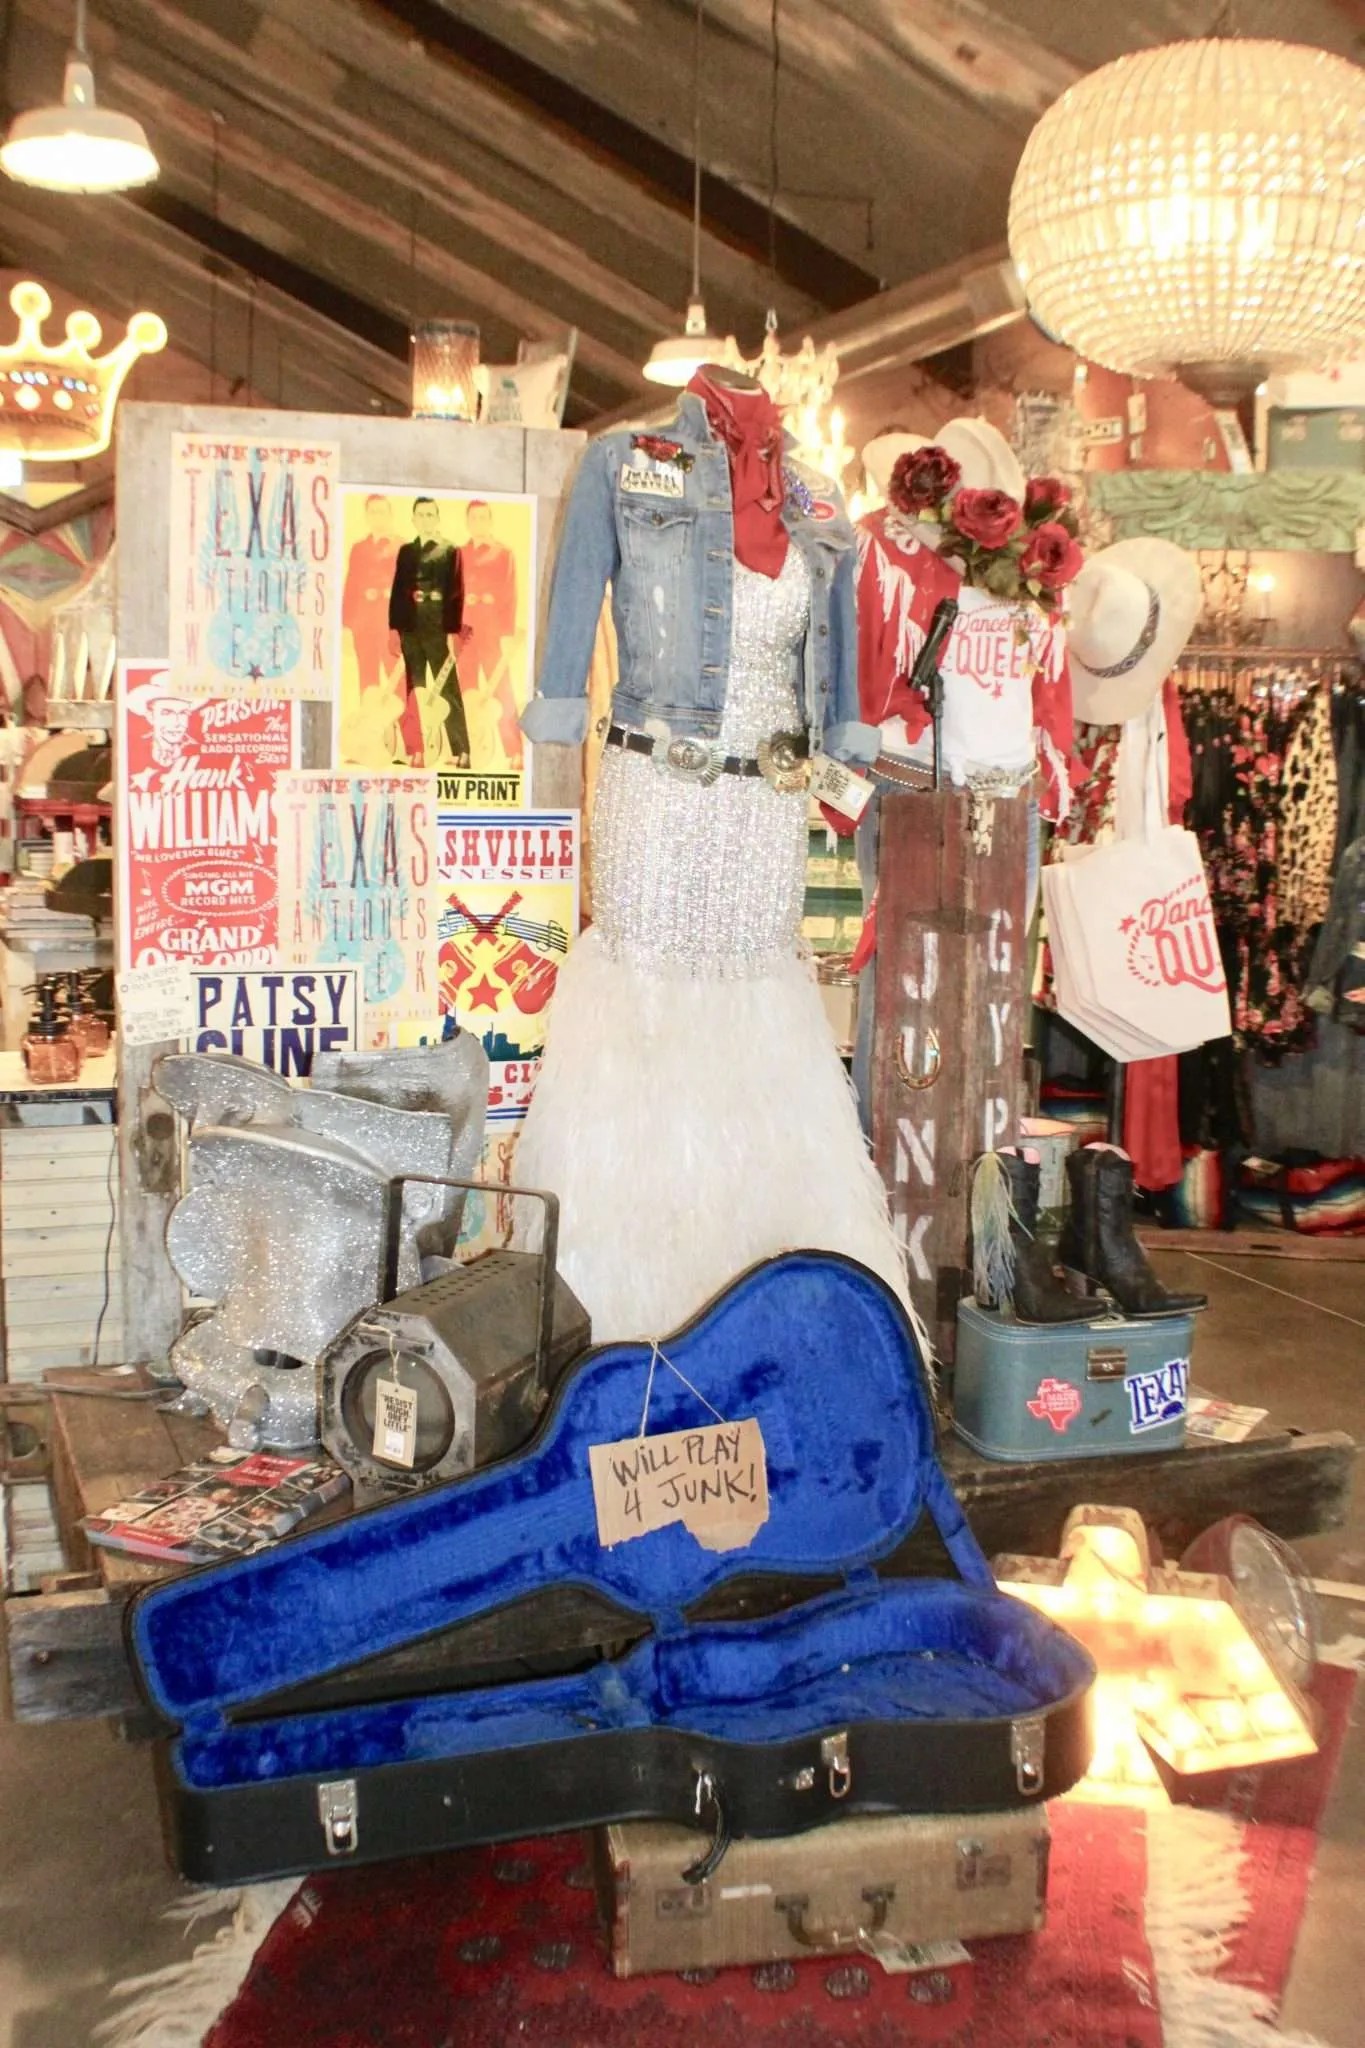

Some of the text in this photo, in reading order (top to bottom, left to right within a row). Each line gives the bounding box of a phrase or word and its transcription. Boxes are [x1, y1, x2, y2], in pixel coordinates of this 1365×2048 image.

[184, 468, 330, 561] TEXAS
[185, 568, 325, 616] ANTIQUES
[954, 610, 1040, 636] Dance
[185, 623, 323, 671] WEEK
[201, 743, 289, 754] RADIO RECORDING
[204, 733, 289, 744] SENSATIONAL
[160, 754, 246, 799] Hank
[465, 780, 520, 801] PRINT
[289, 802, 428, 889] TEXAS
[437, 829, 573, 867] SHVILLE
[184, 879, 255, 896] MGM
[438, 868, 574, 880] NNESSEE
[180, 894, 257, 907] RECORD HITS
[157, 925, 263, 954] GRAND
[292, 898, 427, 943] ANTIQUES
[196, 974, 348, 1028] PATSY
[1127, 1361, 1189, 1426] TEXA
[681, 1426, 741, 1465] PLAY
[624, 1463, 757, 1522] 4 JUNK!
